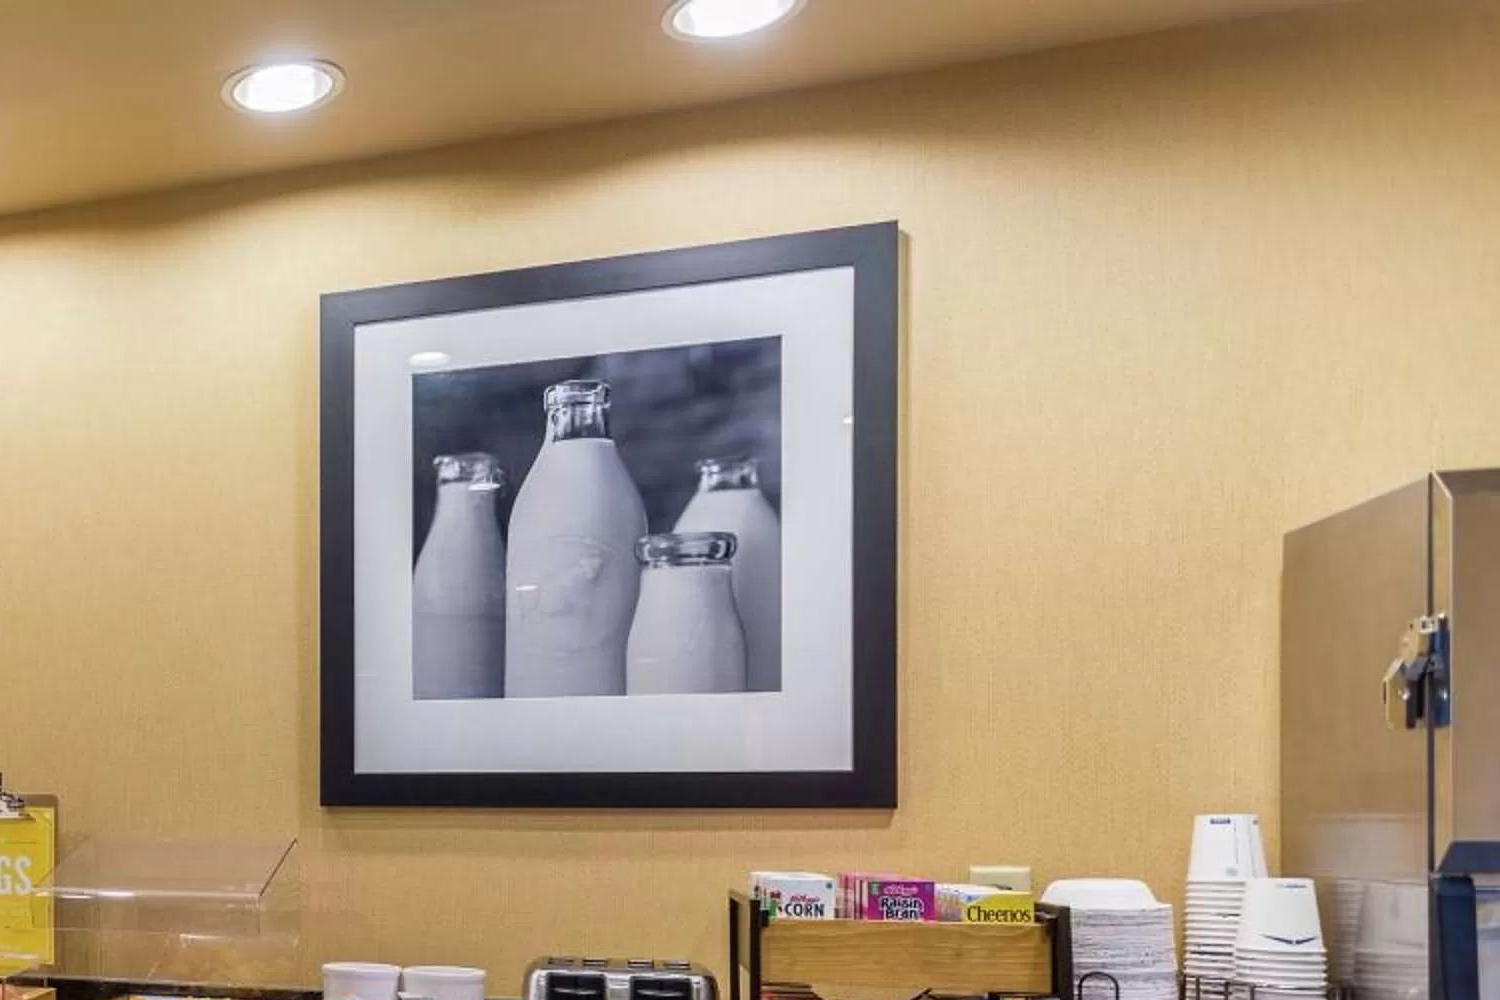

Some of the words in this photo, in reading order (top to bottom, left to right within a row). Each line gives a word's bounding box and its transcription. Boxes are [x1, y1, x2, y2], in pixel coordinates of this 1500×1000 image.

[784, 903, 825, 918] CORN
[880, 897, 923, 910] Raisin
[884, 908, 918, 919] Bran
[966, 905, 1031, 922] Cheerios
